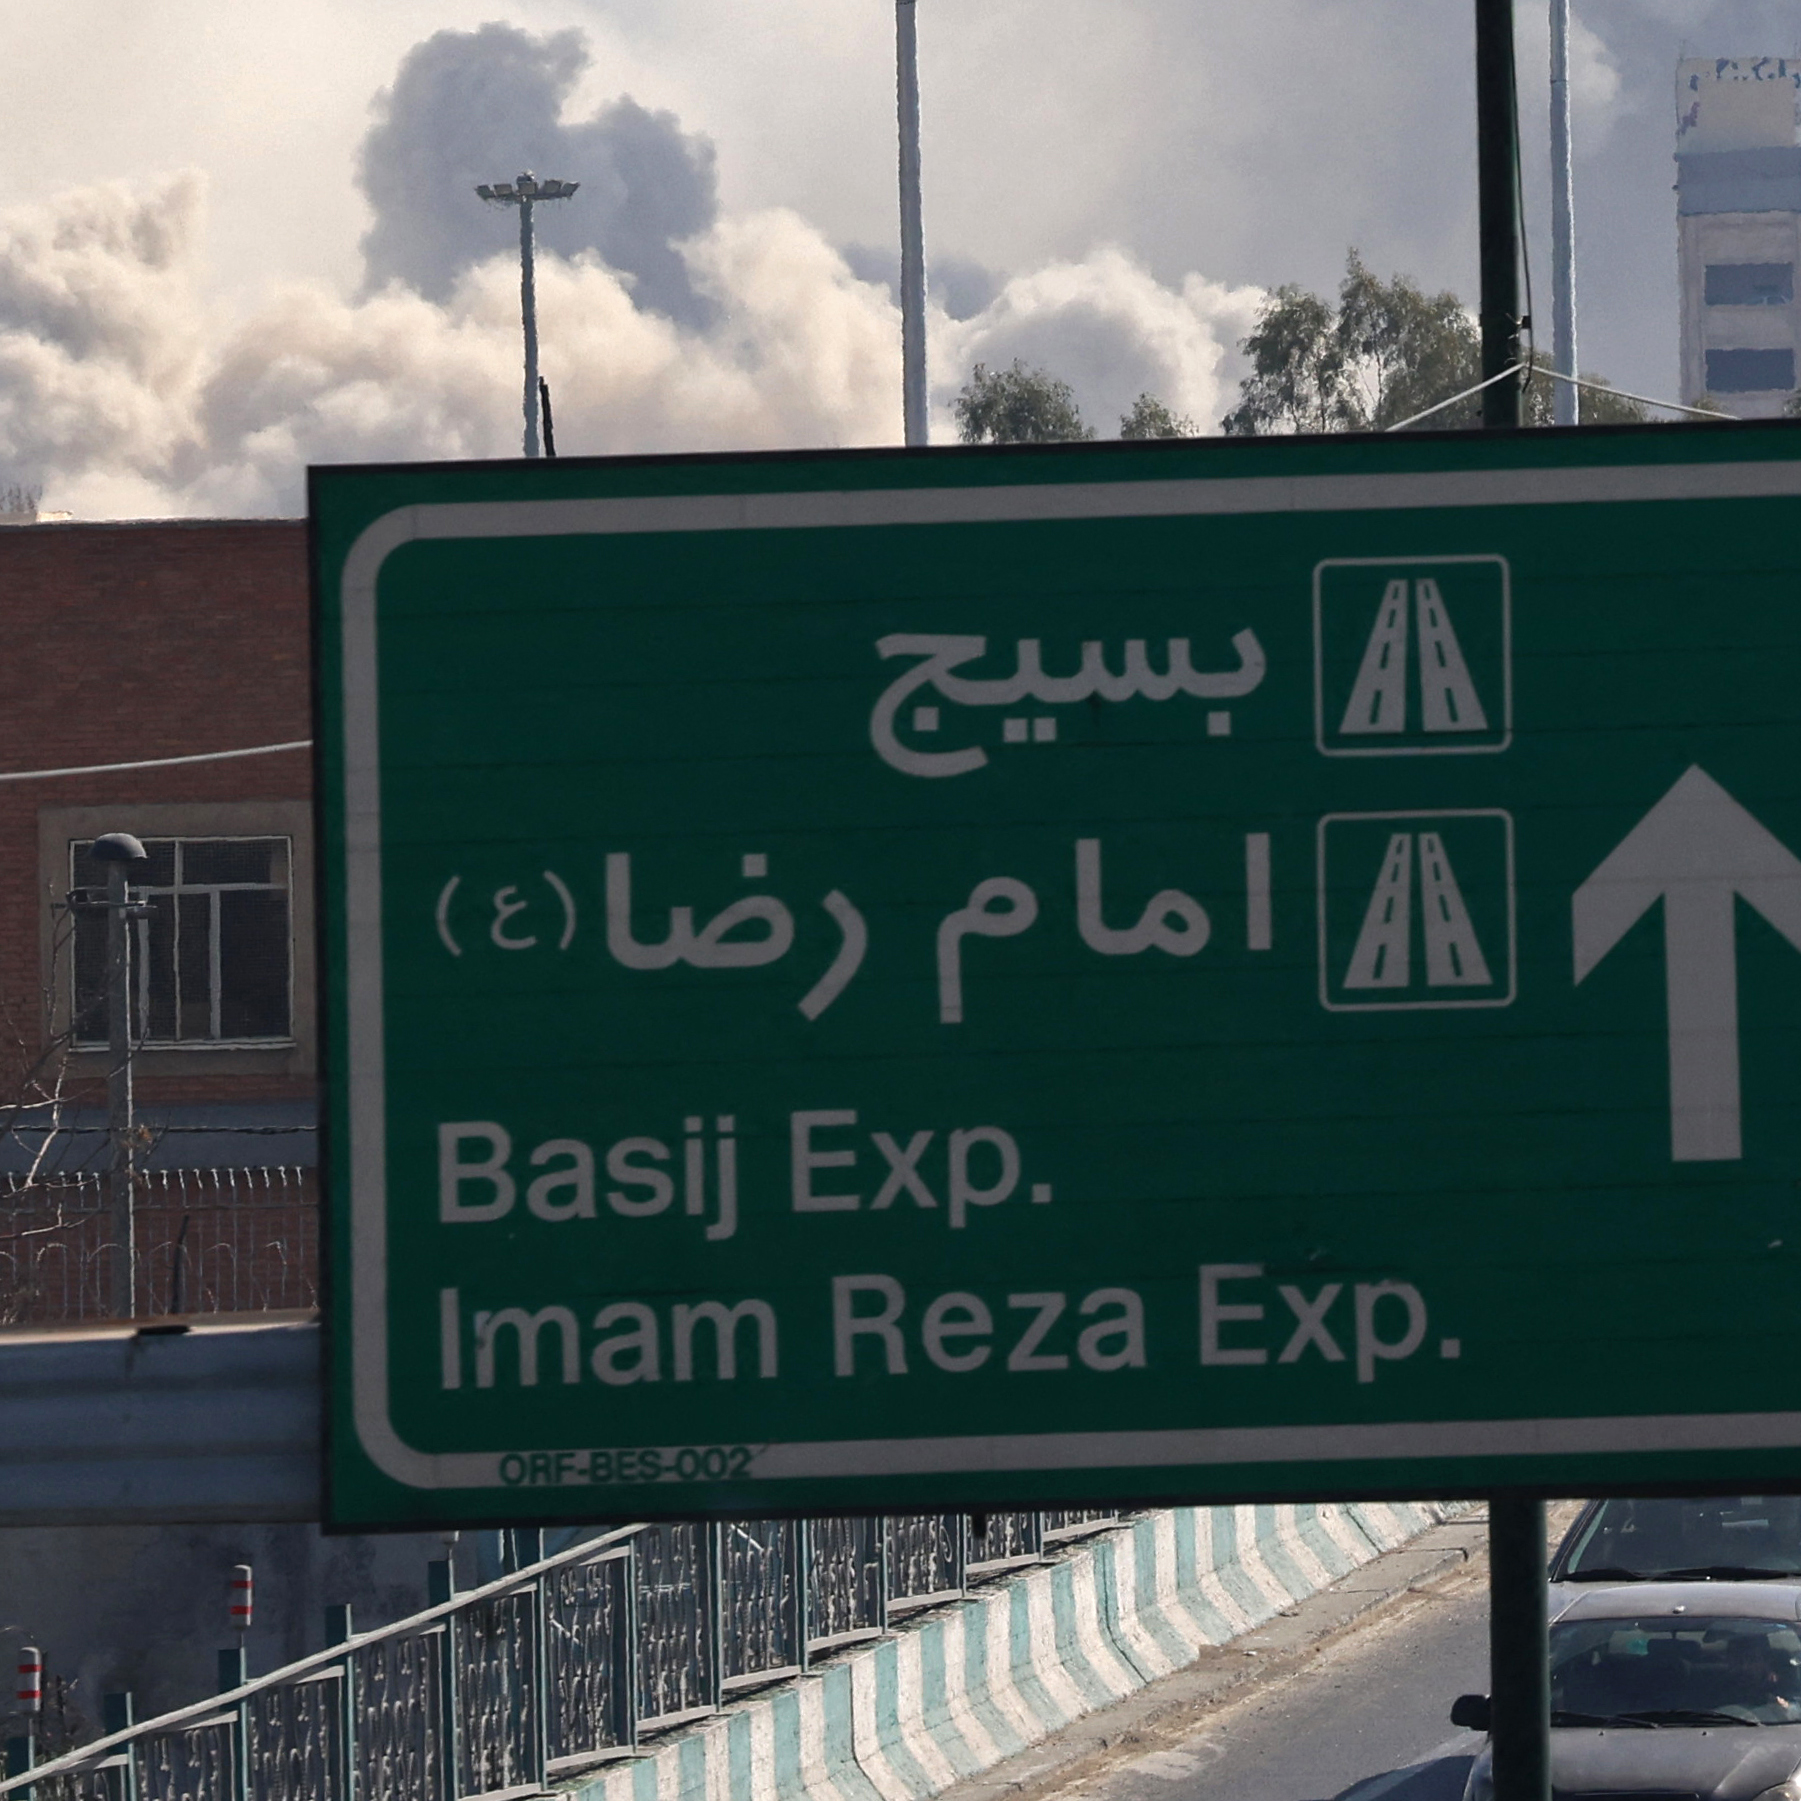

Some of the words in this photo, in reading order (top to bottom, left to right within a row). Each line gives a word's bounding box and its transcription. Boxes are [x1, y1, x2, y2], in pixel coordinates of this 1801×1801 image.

[871, 629, 1265, 777] بسیج
[438, 871, 575, 955] (ع)
[606, 853, 867, 1020] رضا
[937, 833, 1271, 1023] امام
[439, 1115, 736, 1240] Basij
[791, 1110, 1051, 1228] Exp.
[441, 1288, 776, 1389] Imam
[834, 1274, 1145, 1376] Reza
[1200, 1264, 1459, 1382] Exp.
[498, 1447, 753, 1483] ORF-BES-002
